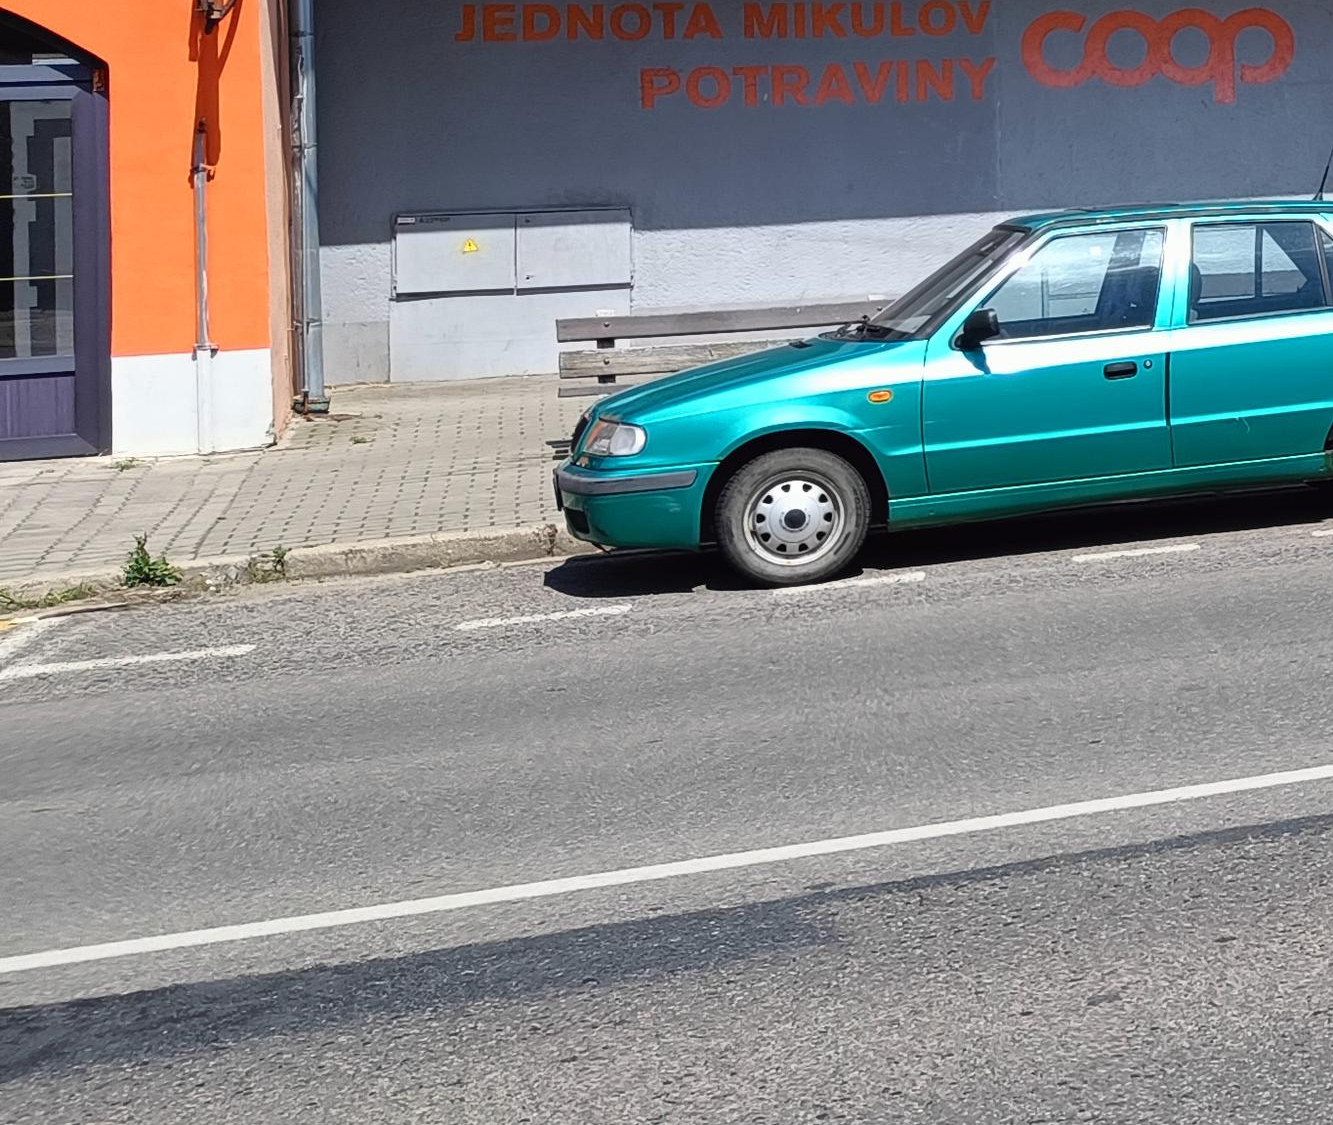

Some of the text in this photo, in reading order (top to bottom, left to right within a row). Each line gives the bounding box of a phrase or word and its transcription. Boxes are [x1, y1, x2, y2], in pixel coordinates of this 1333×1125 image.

[454, 0, 991, 43] JEDNOTA MIKULOV
[1021, 7, 1295, 103] coop
[640, 57, 996, 110] POTRAVINY
